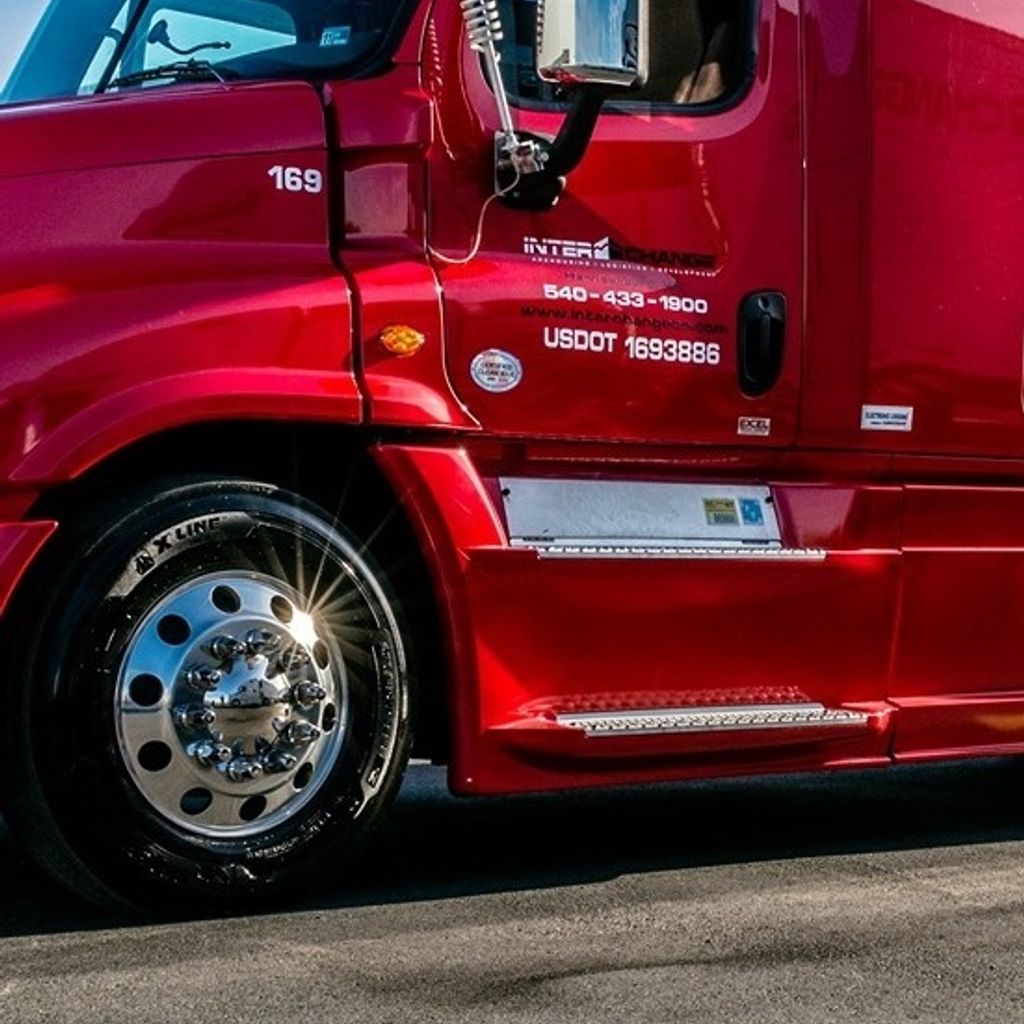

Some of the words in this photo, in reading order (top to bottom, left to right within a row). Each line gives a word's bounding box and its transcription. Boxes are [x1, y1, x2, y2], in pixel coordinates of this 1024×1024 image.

[267, 165, 323, 193] 169
[543, 284, 708, 314] 540-433-1900
[543, 326, 618, 353] USDOT
[624, 336, 721, 365] 1693886
